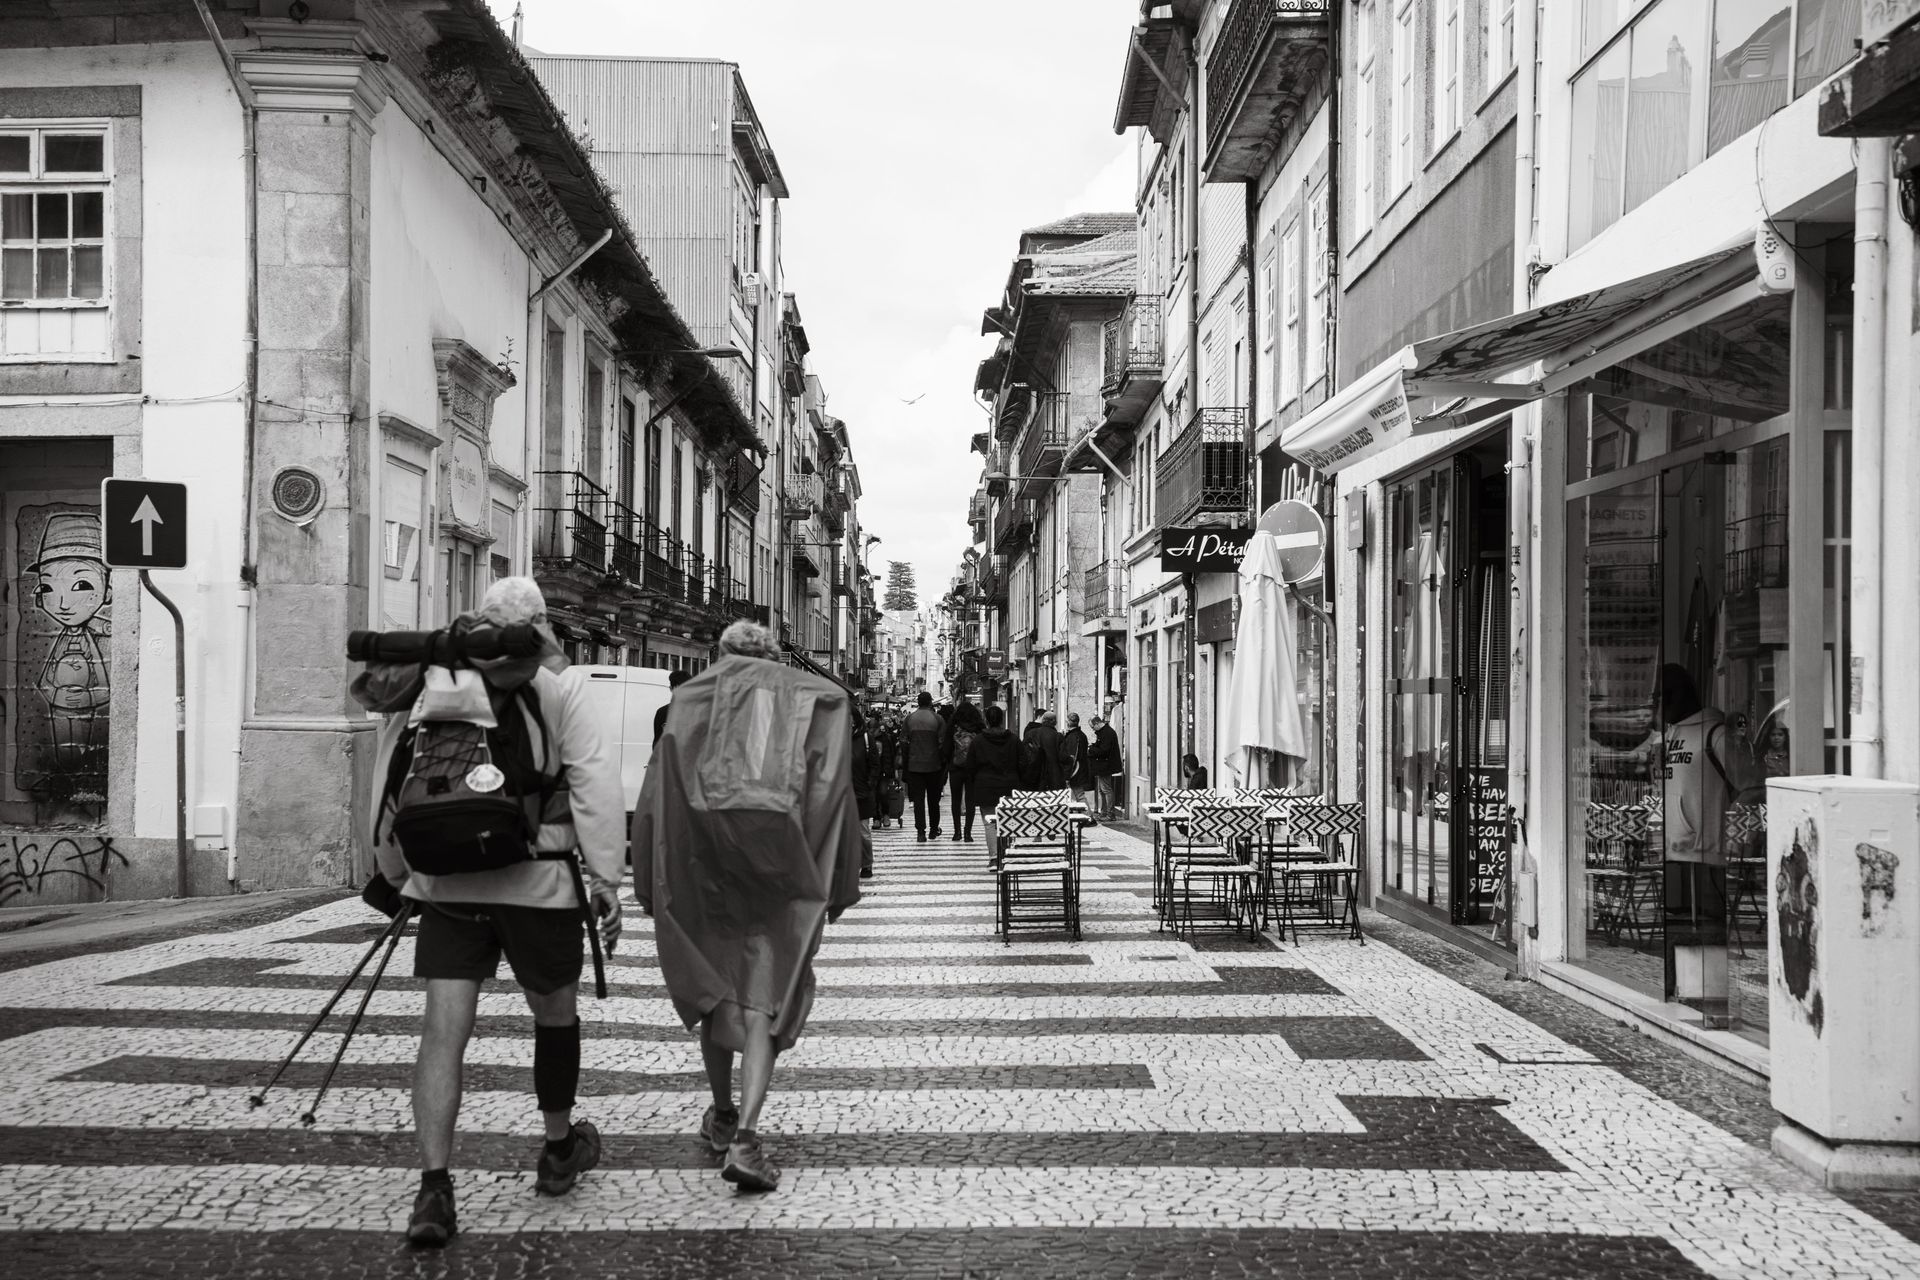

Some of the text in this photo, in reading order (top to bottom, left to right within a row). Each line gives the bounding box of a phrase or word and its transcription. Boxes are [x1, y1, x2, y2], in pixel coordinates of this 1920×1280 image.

[1166, 534, 1252, 563] A Pétal
[870, 670, 884, 678] HOTEL
[1481, 788, 1506, 801] HAV
[1614, 780, 1637, 806] GROW
[1478, 803, 1506, 821] BEE
